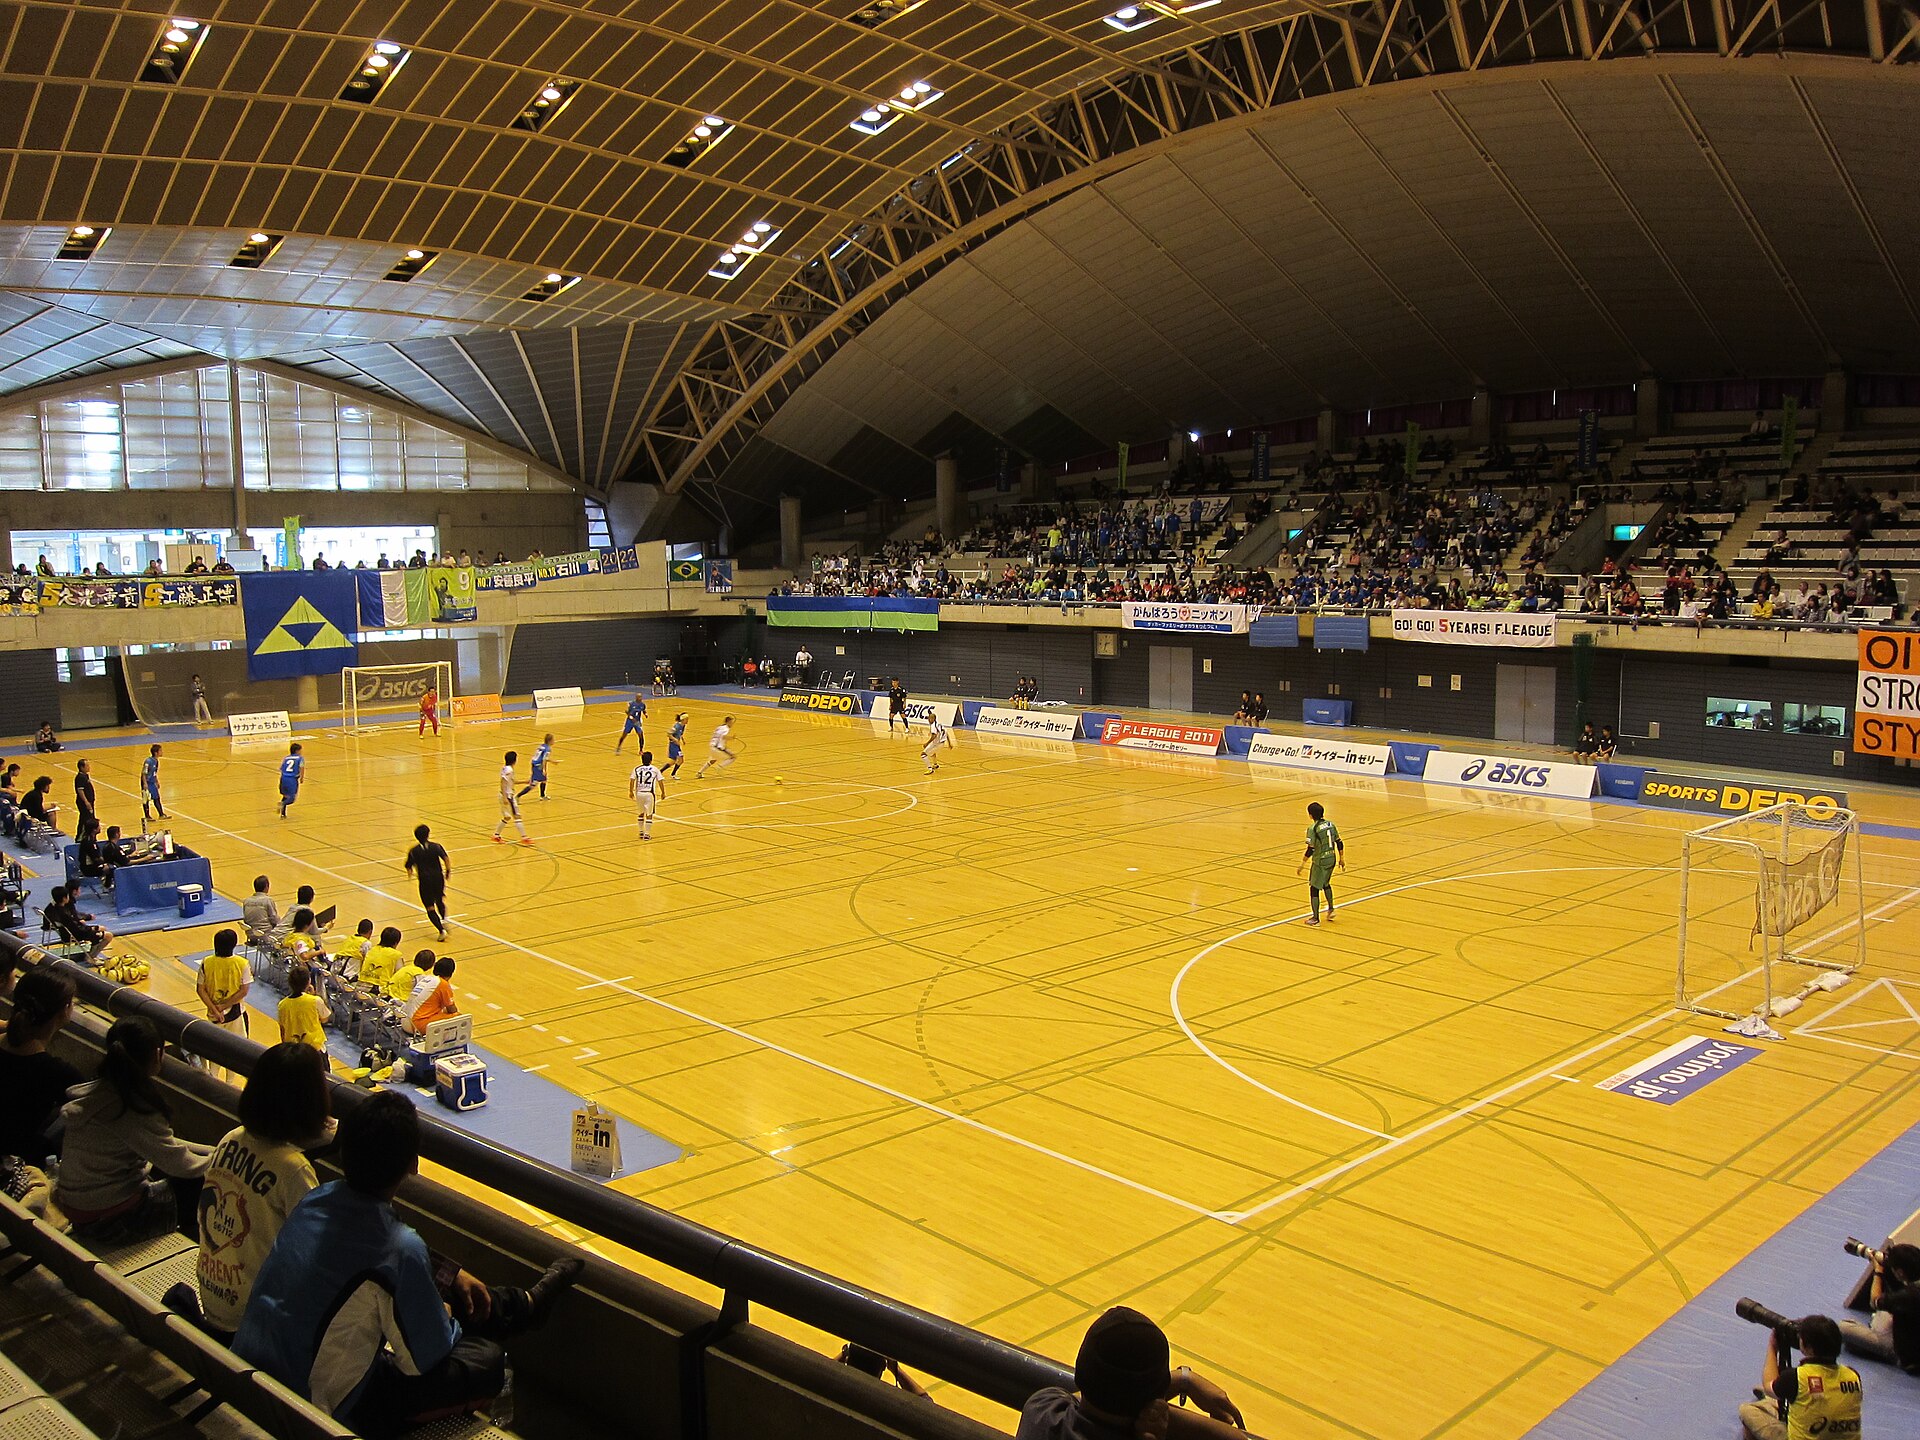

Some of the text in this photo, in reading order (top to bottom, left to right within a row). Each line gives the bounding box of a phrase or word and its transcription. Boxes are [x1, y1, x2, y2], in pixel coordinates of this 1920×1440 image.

[459, 572, 470, 590] 9
[40, 582, 63, 606] 5
[1133, 606, 1233, 621] がんばろう ニッポン!
[1394, 620, 1412, 631] GO!
[1416, 621, 1434, 631] GO!
[1495, 623, 1552, 636] F.LEAGUE
[1866, 636, 1920, 669] OI
[781, 693, 852, 711] SPORTS DEPO
[233, 720, 288, 732] サカナのちから
[980, 715, 1000, 726] Charge
[1122, 725, 1182, 740] F.LEAGUE
[1184, 731, 1214, 743] 2011
[1252, 743, 1280, 757] Charge
[1285, 746, 1300, 758] Go!
[1313, 749, 1384, 765] ウイダーinゼリー
[286, 759, 294, 772] 2
[1487, 762, 1551, 787] asics
[639, 771, 652, 784] 12
[1644, 782, 1839, 821] SPORTS DEPO
[1628, 1041, 1745, 1099] yorimo.jp
[593, 1123, 610, 1148] in
